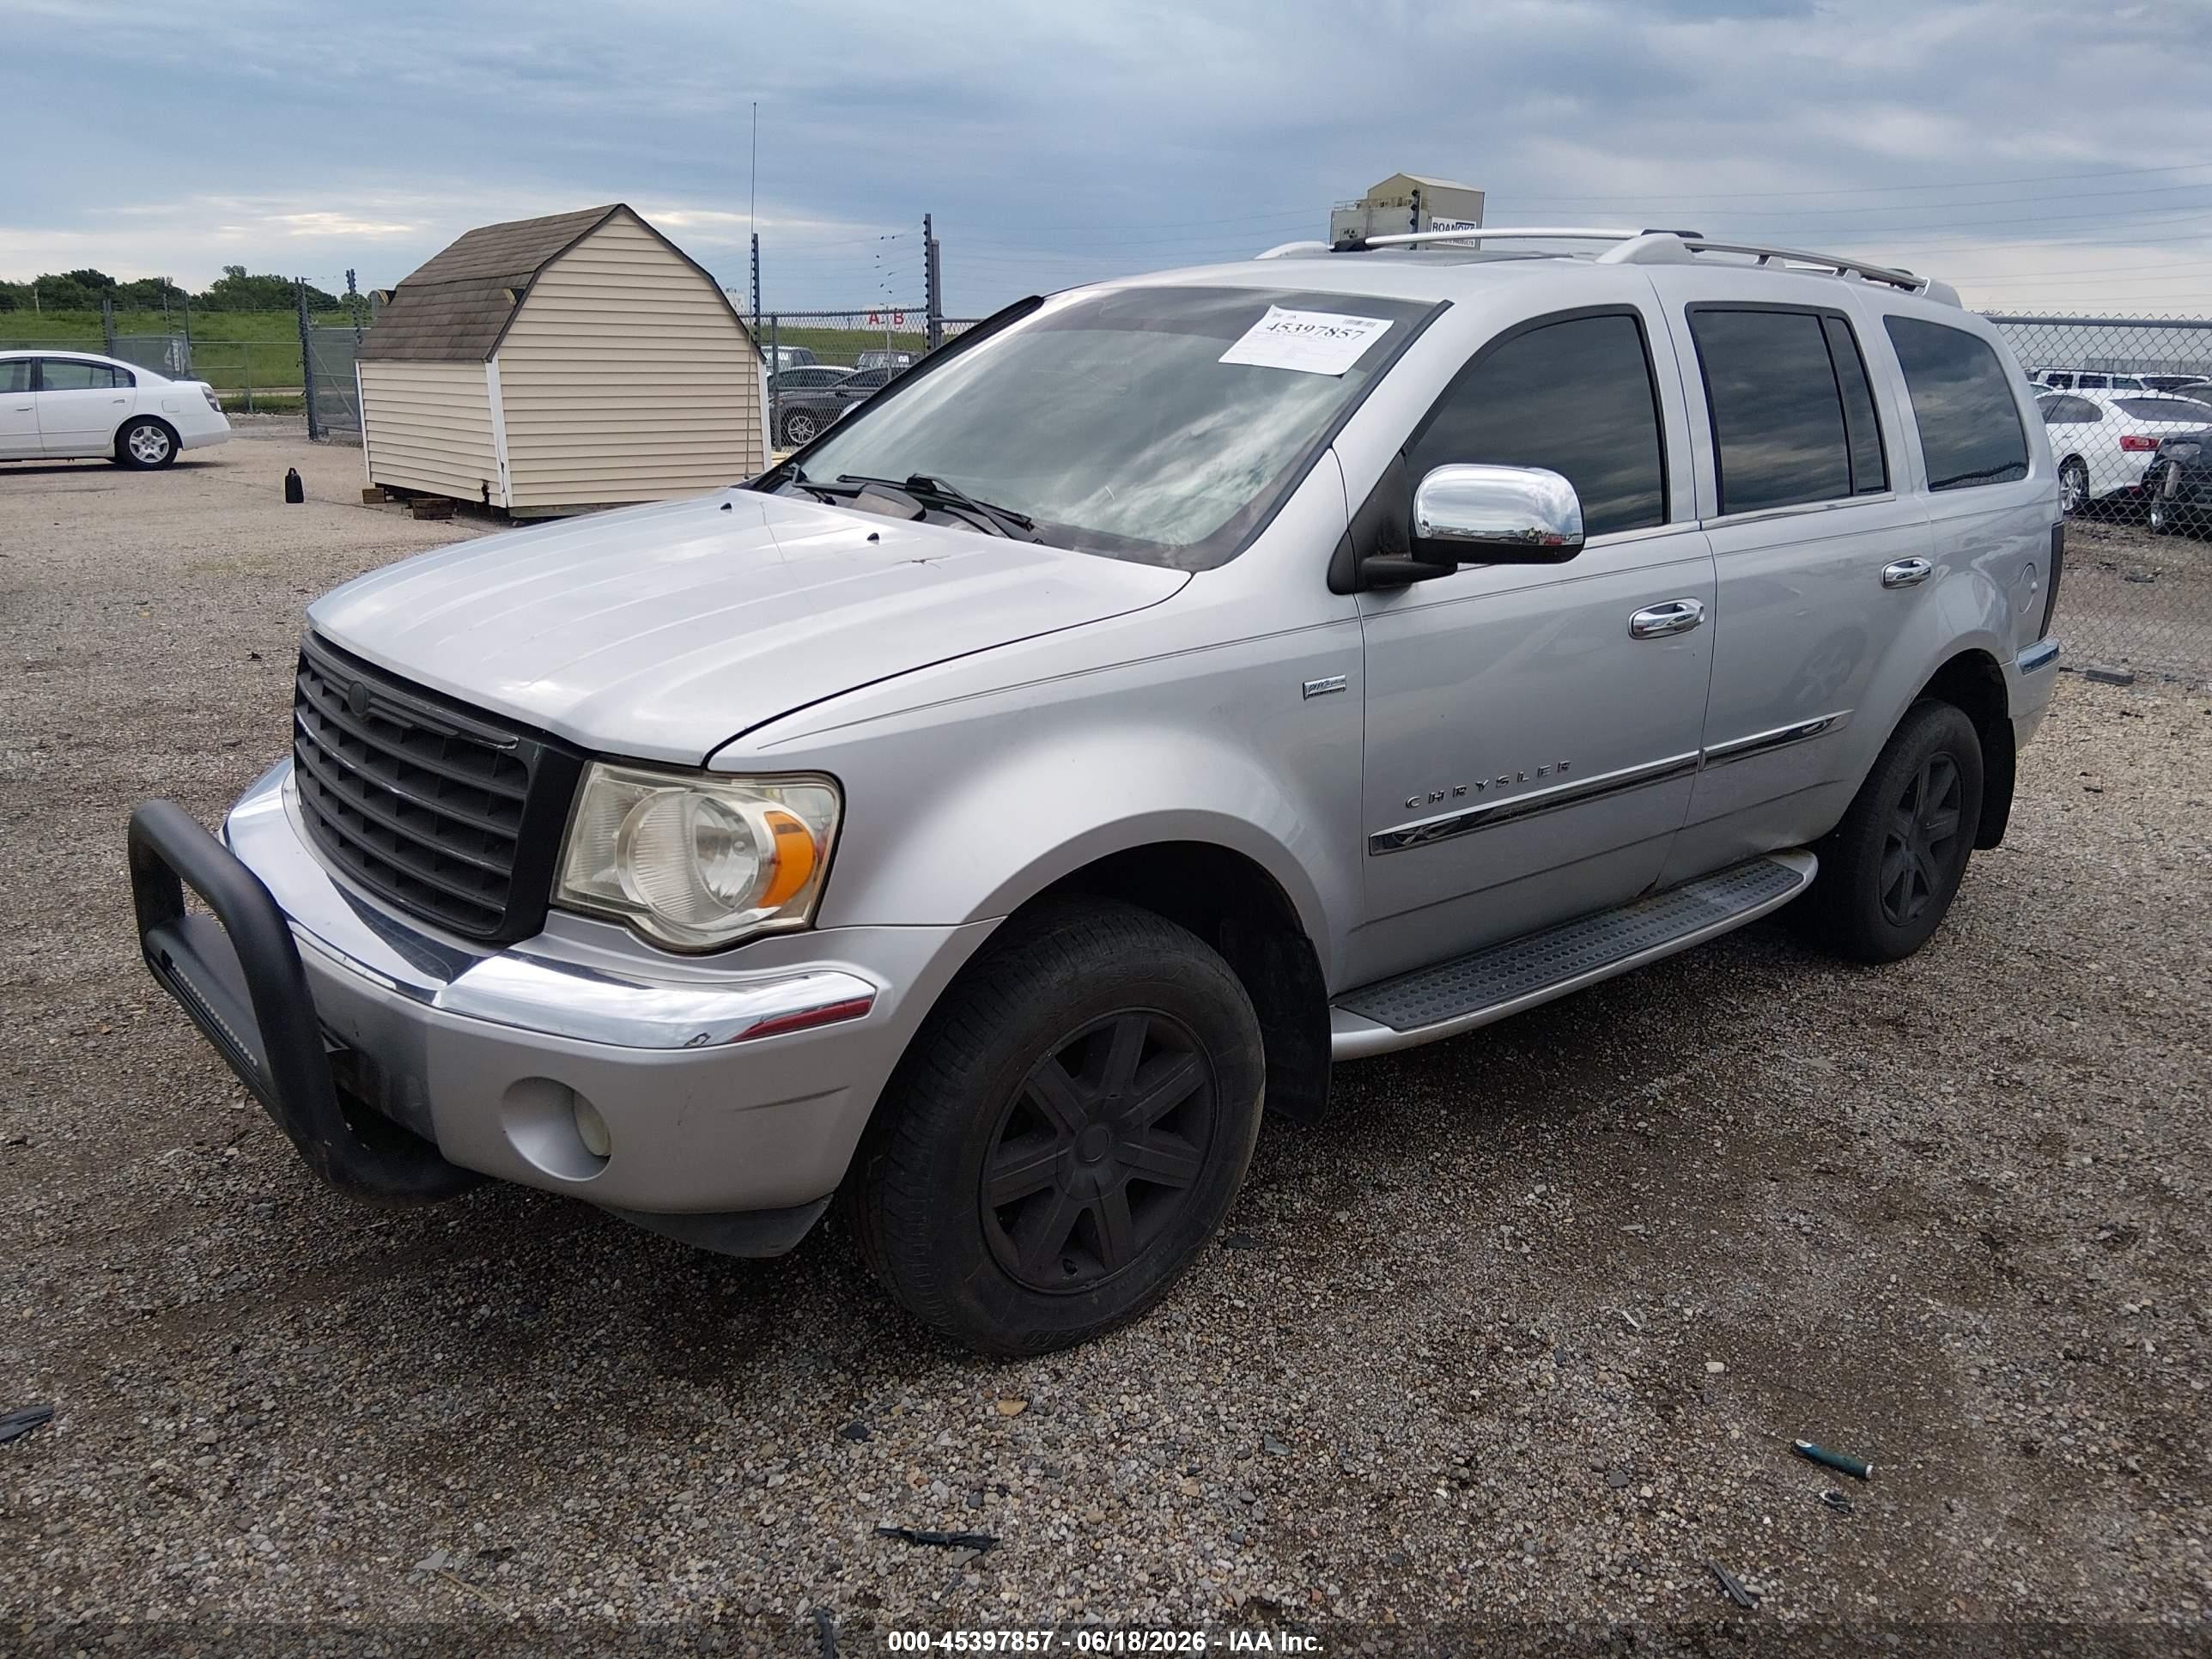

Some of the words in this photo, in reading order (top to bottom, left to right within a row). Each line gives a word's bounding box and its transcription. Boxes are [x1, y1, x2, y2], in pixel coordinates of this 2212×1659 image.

[1432, 222, 1475, 233] ROANO
[868, 311, 880, 325] A
[894, 311, 904, 325] B
[1266, 322, 1366, 341] 45397857
[1405, 760, 1571, 809] CHRYSLER
